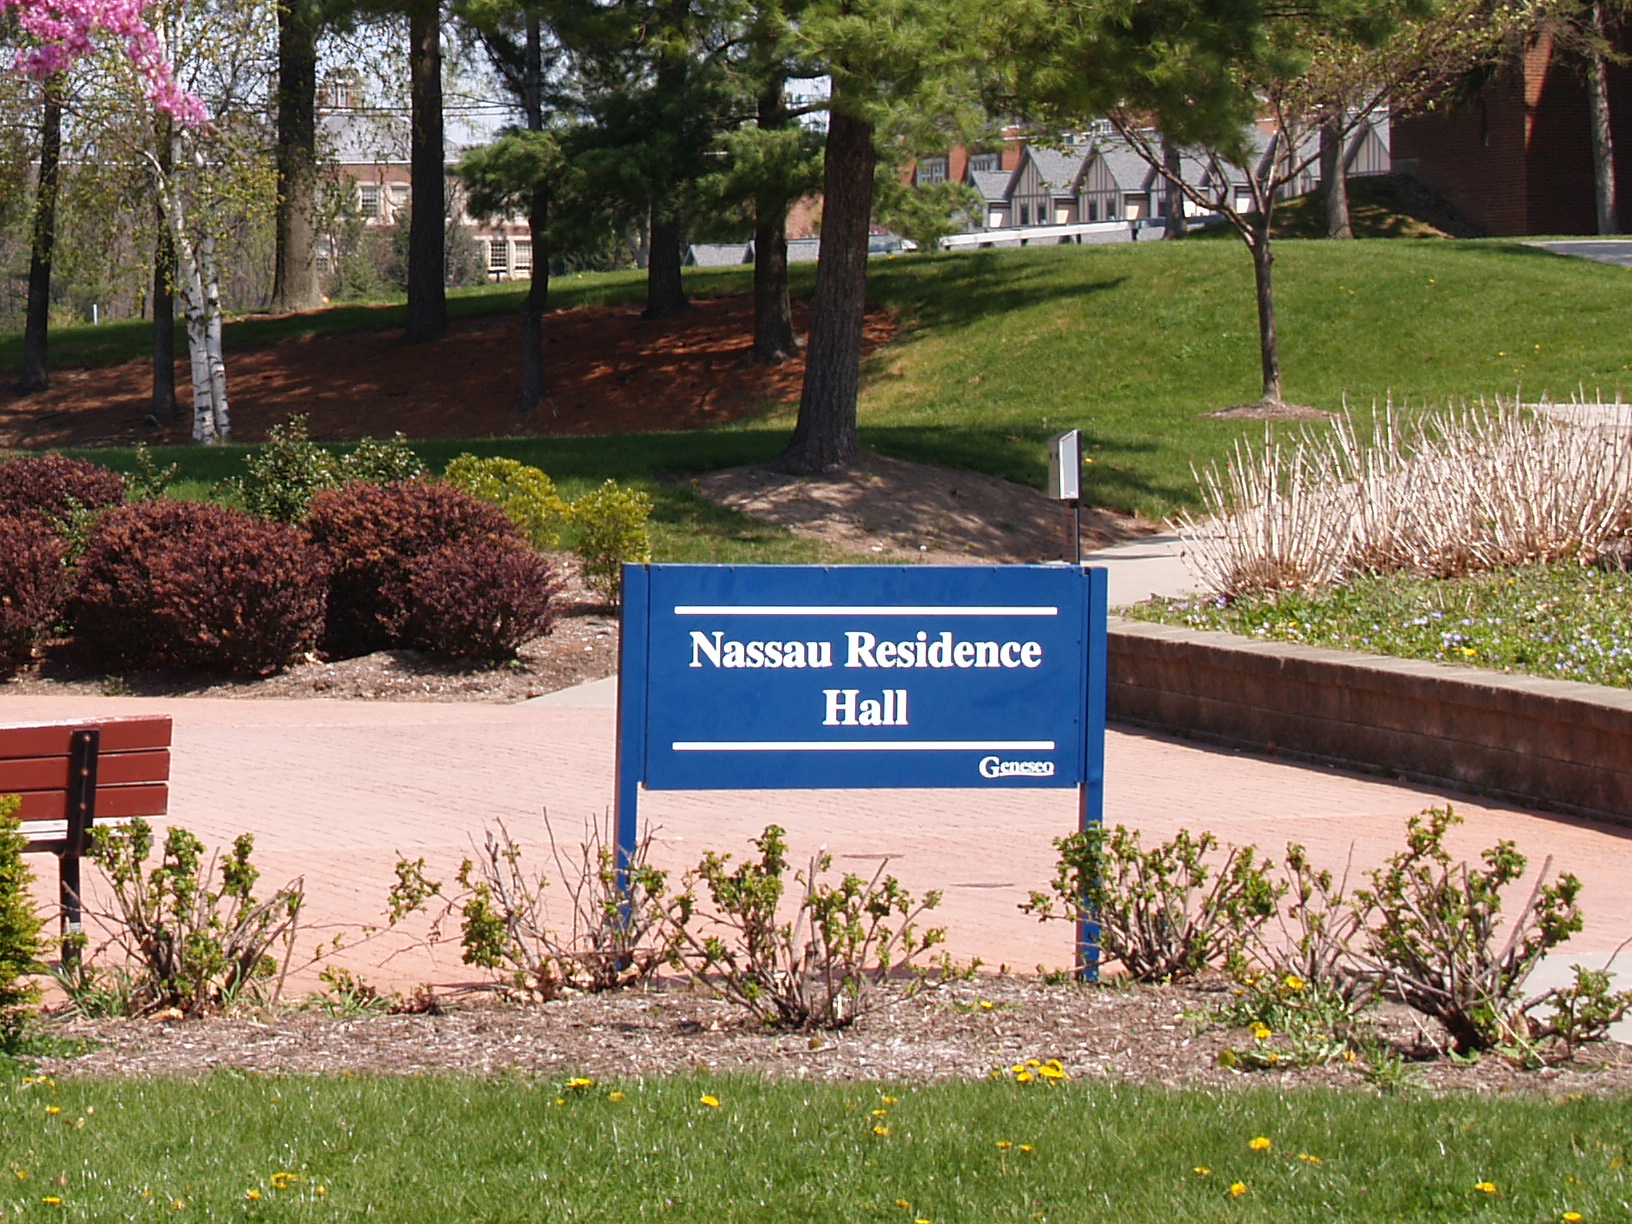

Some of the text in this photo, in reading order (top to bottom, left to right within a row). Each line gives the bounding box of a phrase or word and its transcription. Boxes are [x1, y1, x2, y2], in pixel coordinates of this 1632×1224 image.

[689, 630, 1043, 669] Nassau Residence
[822, 689, 909, 727] Hall
[978, 756, 1055, 779] Geneseo
